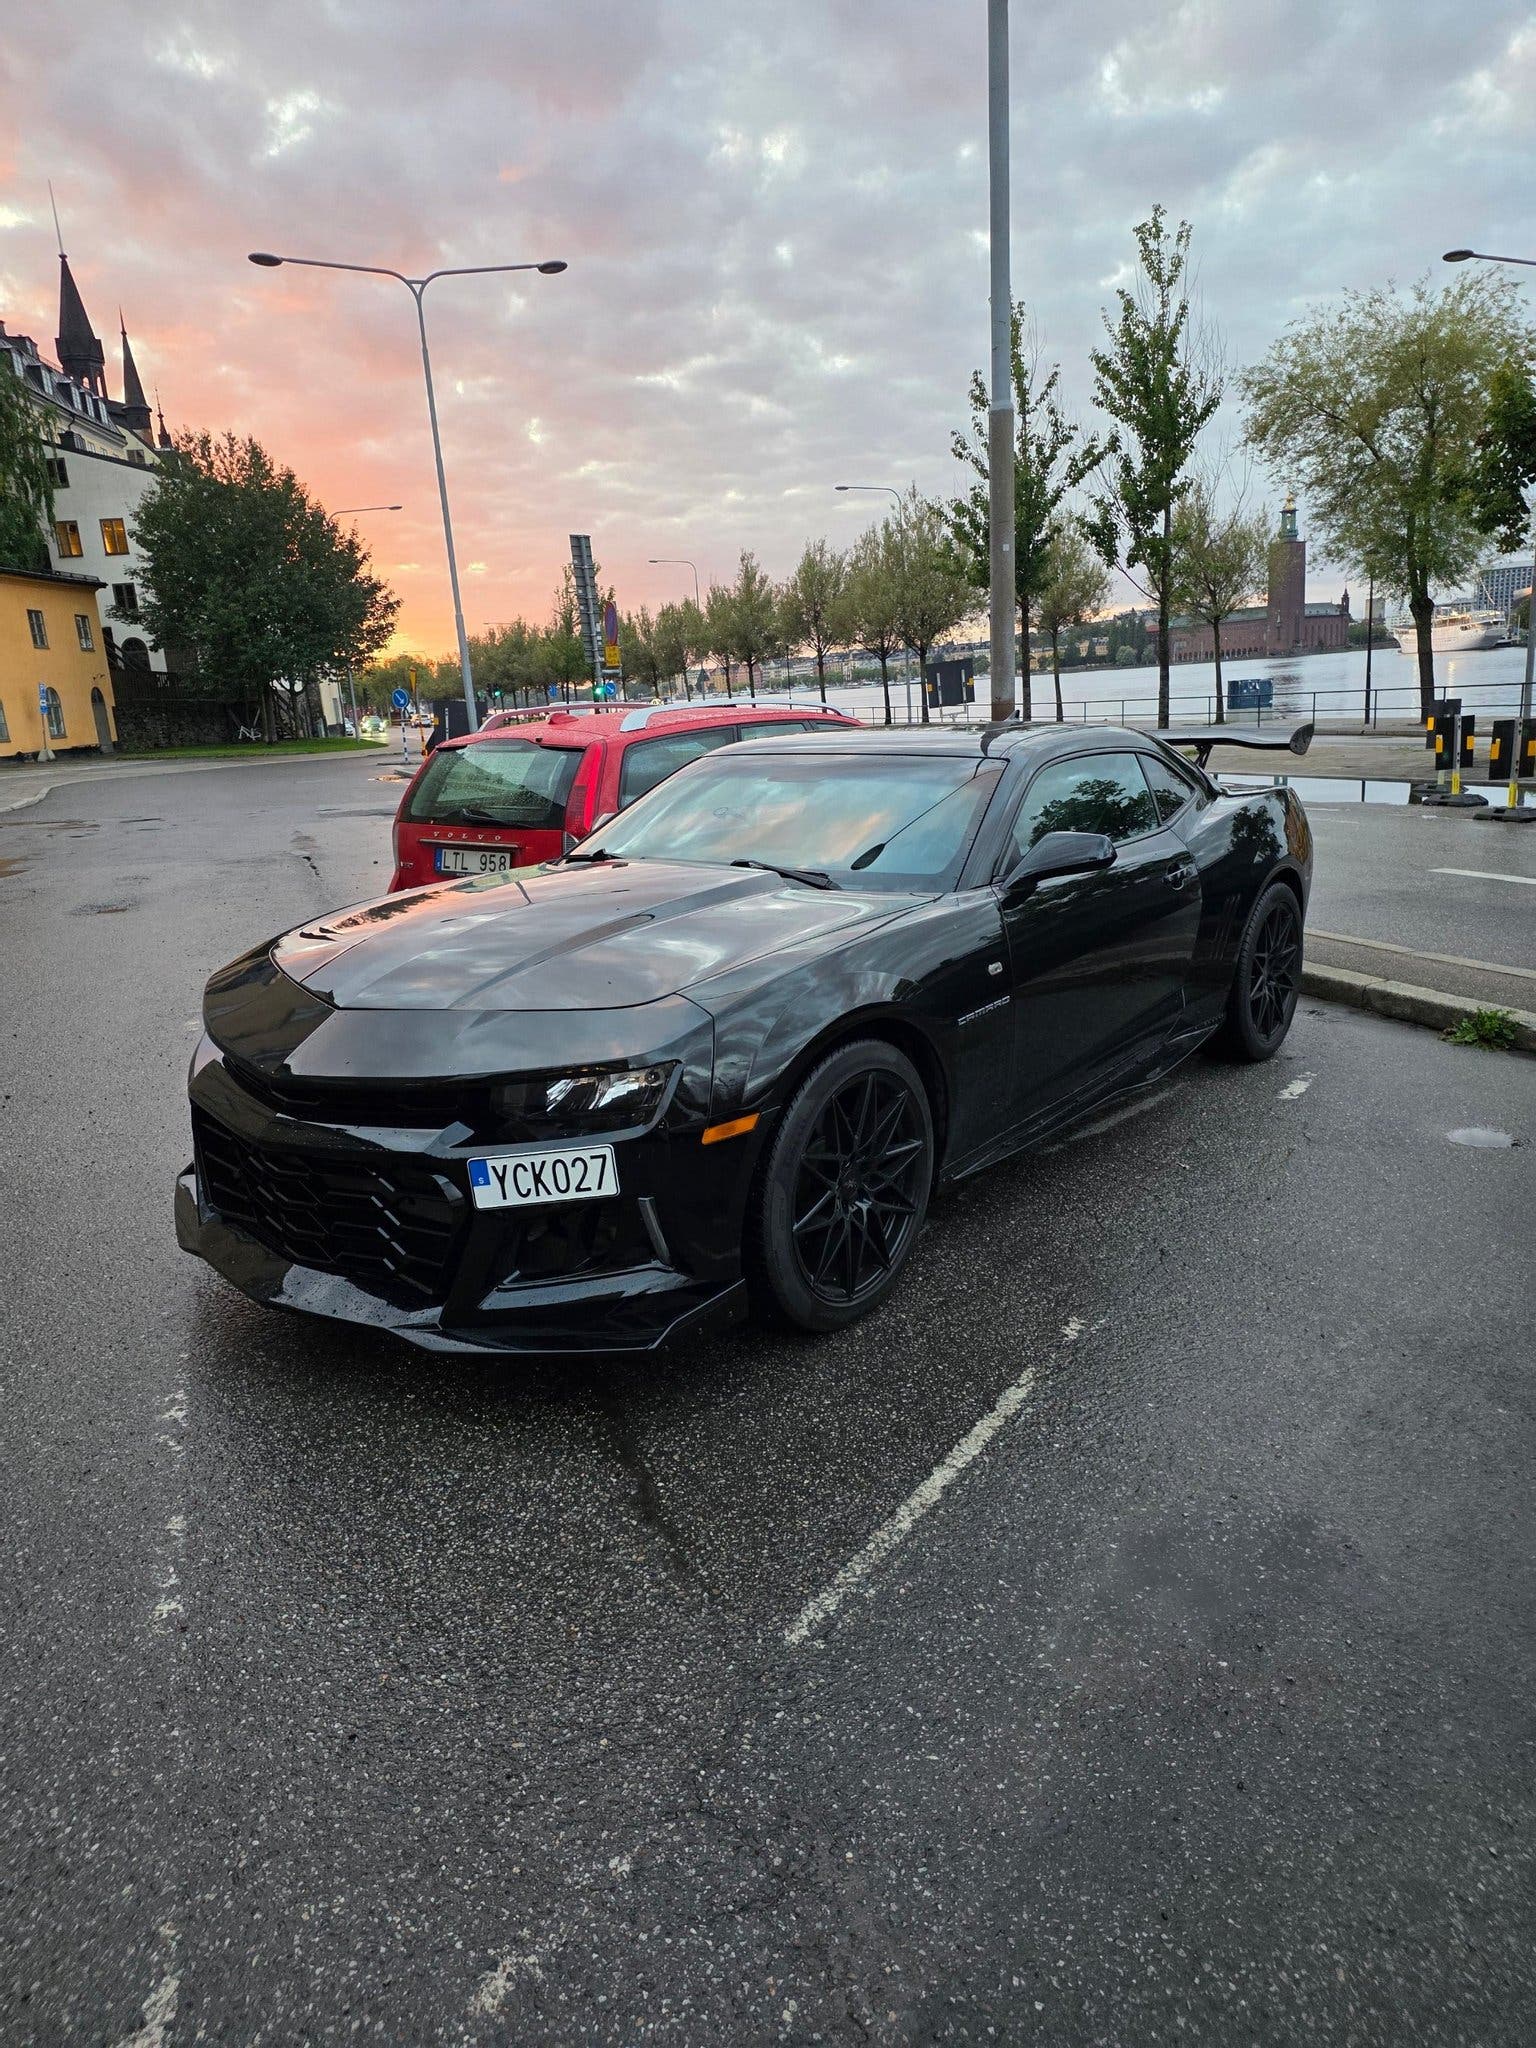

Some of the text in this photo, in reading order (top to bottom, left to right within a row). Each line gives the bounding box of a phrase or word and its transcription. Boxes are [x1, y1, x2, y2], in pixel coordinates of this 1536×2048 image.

[433, 831, 502, 841] VOLVO
[443, 851, 469, 871] LTL
[479, 853, 507, 872] 958
[491, 1154, 607, 1201] YCK027
